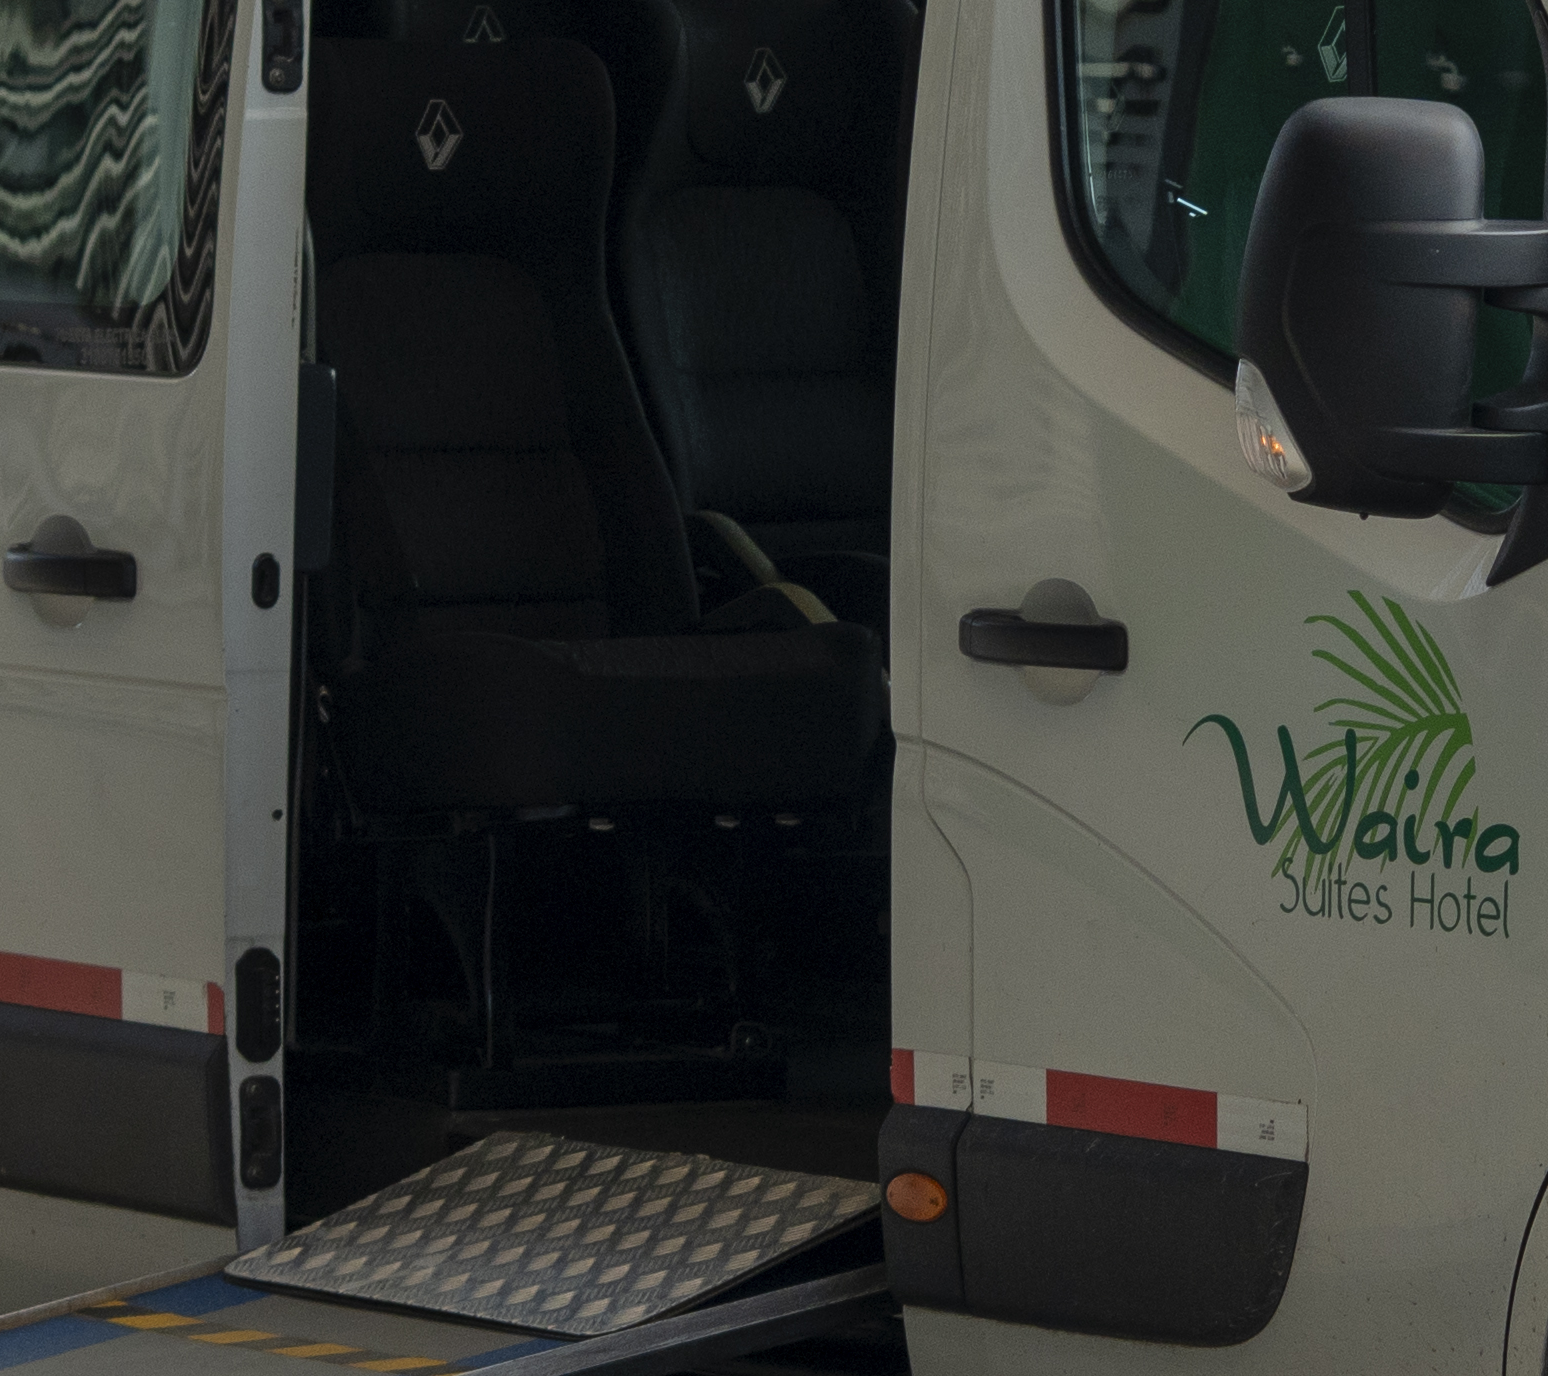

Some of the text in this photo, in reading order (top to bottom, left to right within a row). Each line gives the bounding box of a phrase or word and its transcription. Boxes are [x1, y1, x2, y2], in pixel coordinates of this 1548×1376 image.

[1182, 714, 1521, 876] Waira
[1279, 857, 1511, 940] Suites Hotel
